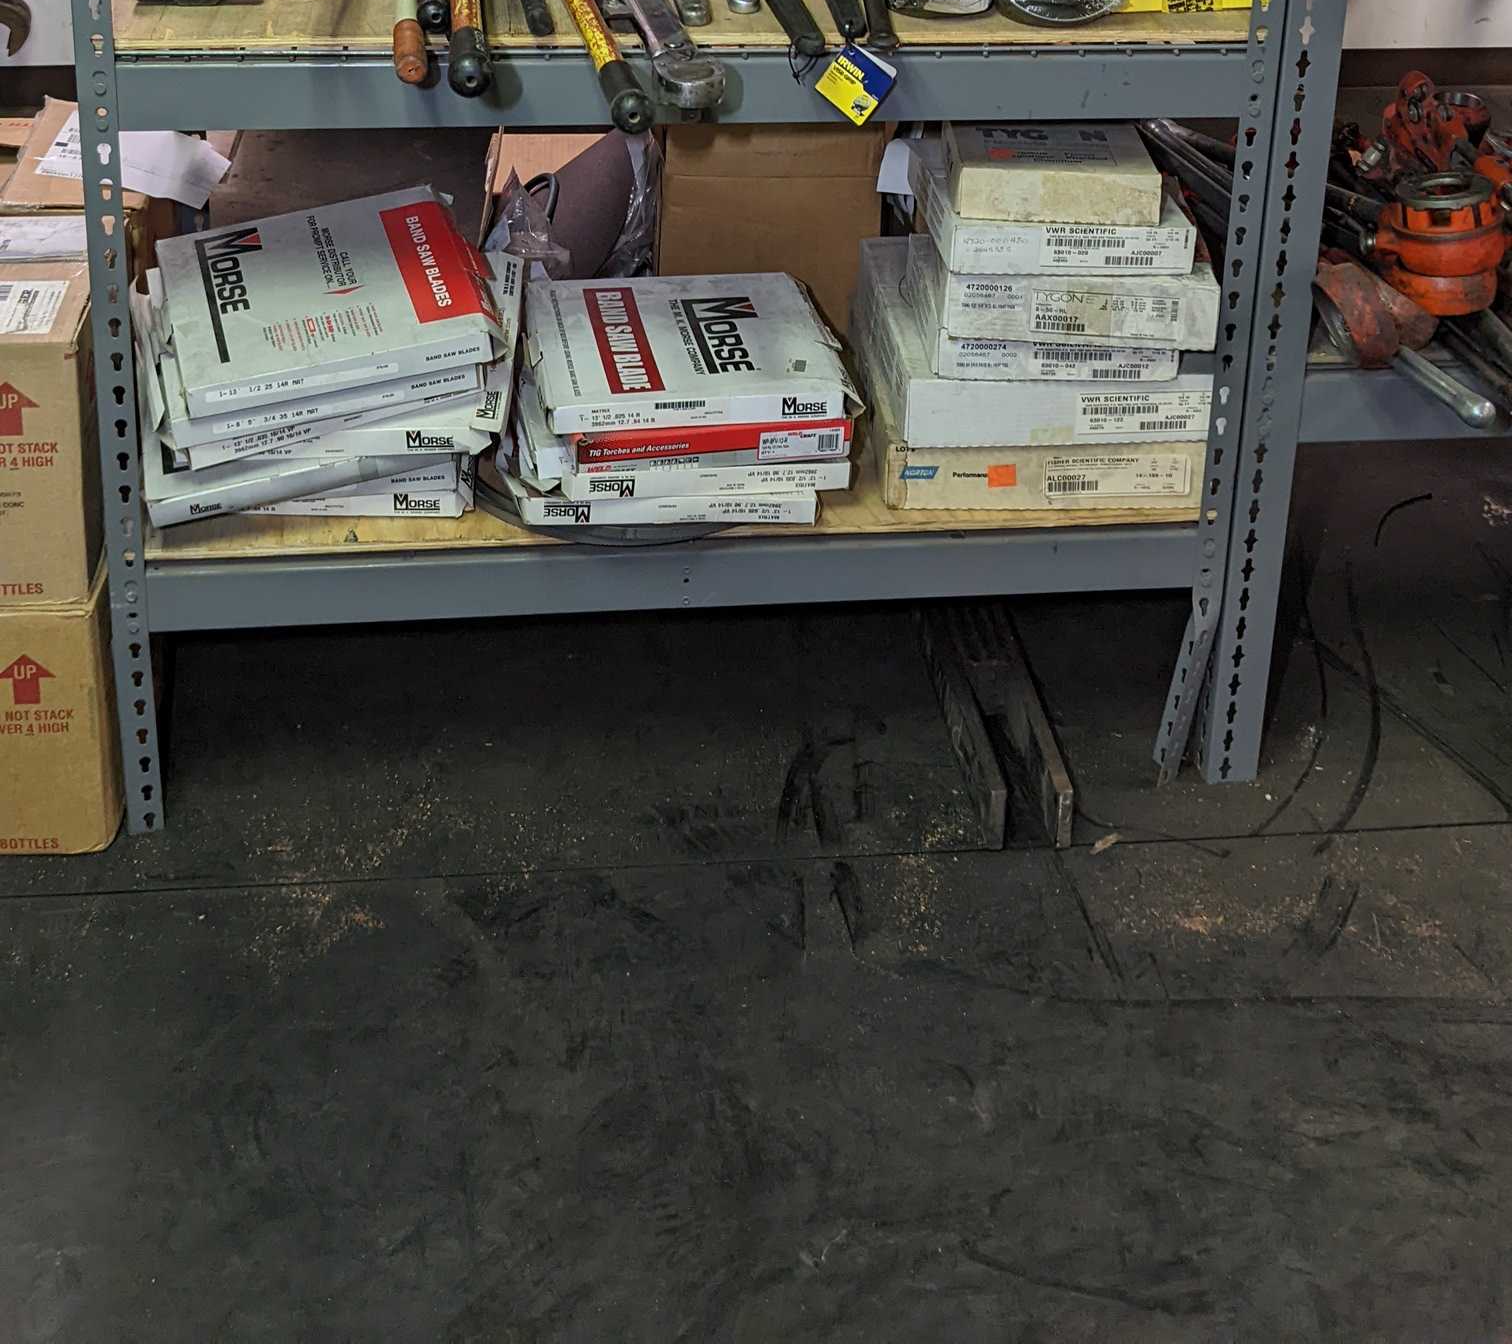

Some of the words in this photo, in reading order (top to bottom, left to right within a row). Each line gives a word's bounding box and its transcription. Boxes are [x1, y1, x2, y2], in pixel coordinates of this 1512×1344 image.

[837, 55, 865, 81] IRWIN
[405, 216, 427, 244] BAND
[1045, 227, 1066, 235] VWR
[1069, 227, 1117, 235] SCIENTIFIC
[416, 243, 437, 267] SAW
[203, 227, 263, 314] MORSE
[425, 266, 452, 307] BLADES
[966, 283, 1013, 292] 4720000126
[1036, 291, 1084, 304] TYGON
[596, 291, 630, 324] BAND
[1035, 314, 1079, 323] AAX00017
[604, 324, 640, 353] SAW
[686, 297, 760, 374] MORSE
[425, 354, 442, 362] BAND
[458, 346, 480, 356] BLADES
[612, 353, 652, 391] BLADE
[411, 382, 428, 390] BAND
[428, 378, 442, 386] SAW
[443, 374, 466, 383] BLADES
[475, 391, 499, 420] MORSE
[782, 397, 828, 415] MORSE
[1103, 394, 1150, 403] SCIENTIFIC
[17, 441, 59, 454] STACK
[406, 431, 455, 448] MORSE
[589, 448, 601, 457] TIG
[603, 446, 631, 455] Torches
[631, 444, 646, 453] and
[646, 441, 690, 453] Accessories
[10, 456, 19, 468] 4
[22, 456, 54, 468] HIGH
[952, 471, 988, 479] Performanc
[589, 479, 636, 498] MORSE
[393, 493, 441, 511] MORSE
[543, 507, 590, 523] MORSE
[13, 664, 37, 680] UP
[5, 710, 31, 722] NOT
[34, 708, 75, 721] STACK
[26, 723, 35, 734] 4
[37, 721, 70, 734] HIGH
[0, 837, 60, 850] BOTTLES
